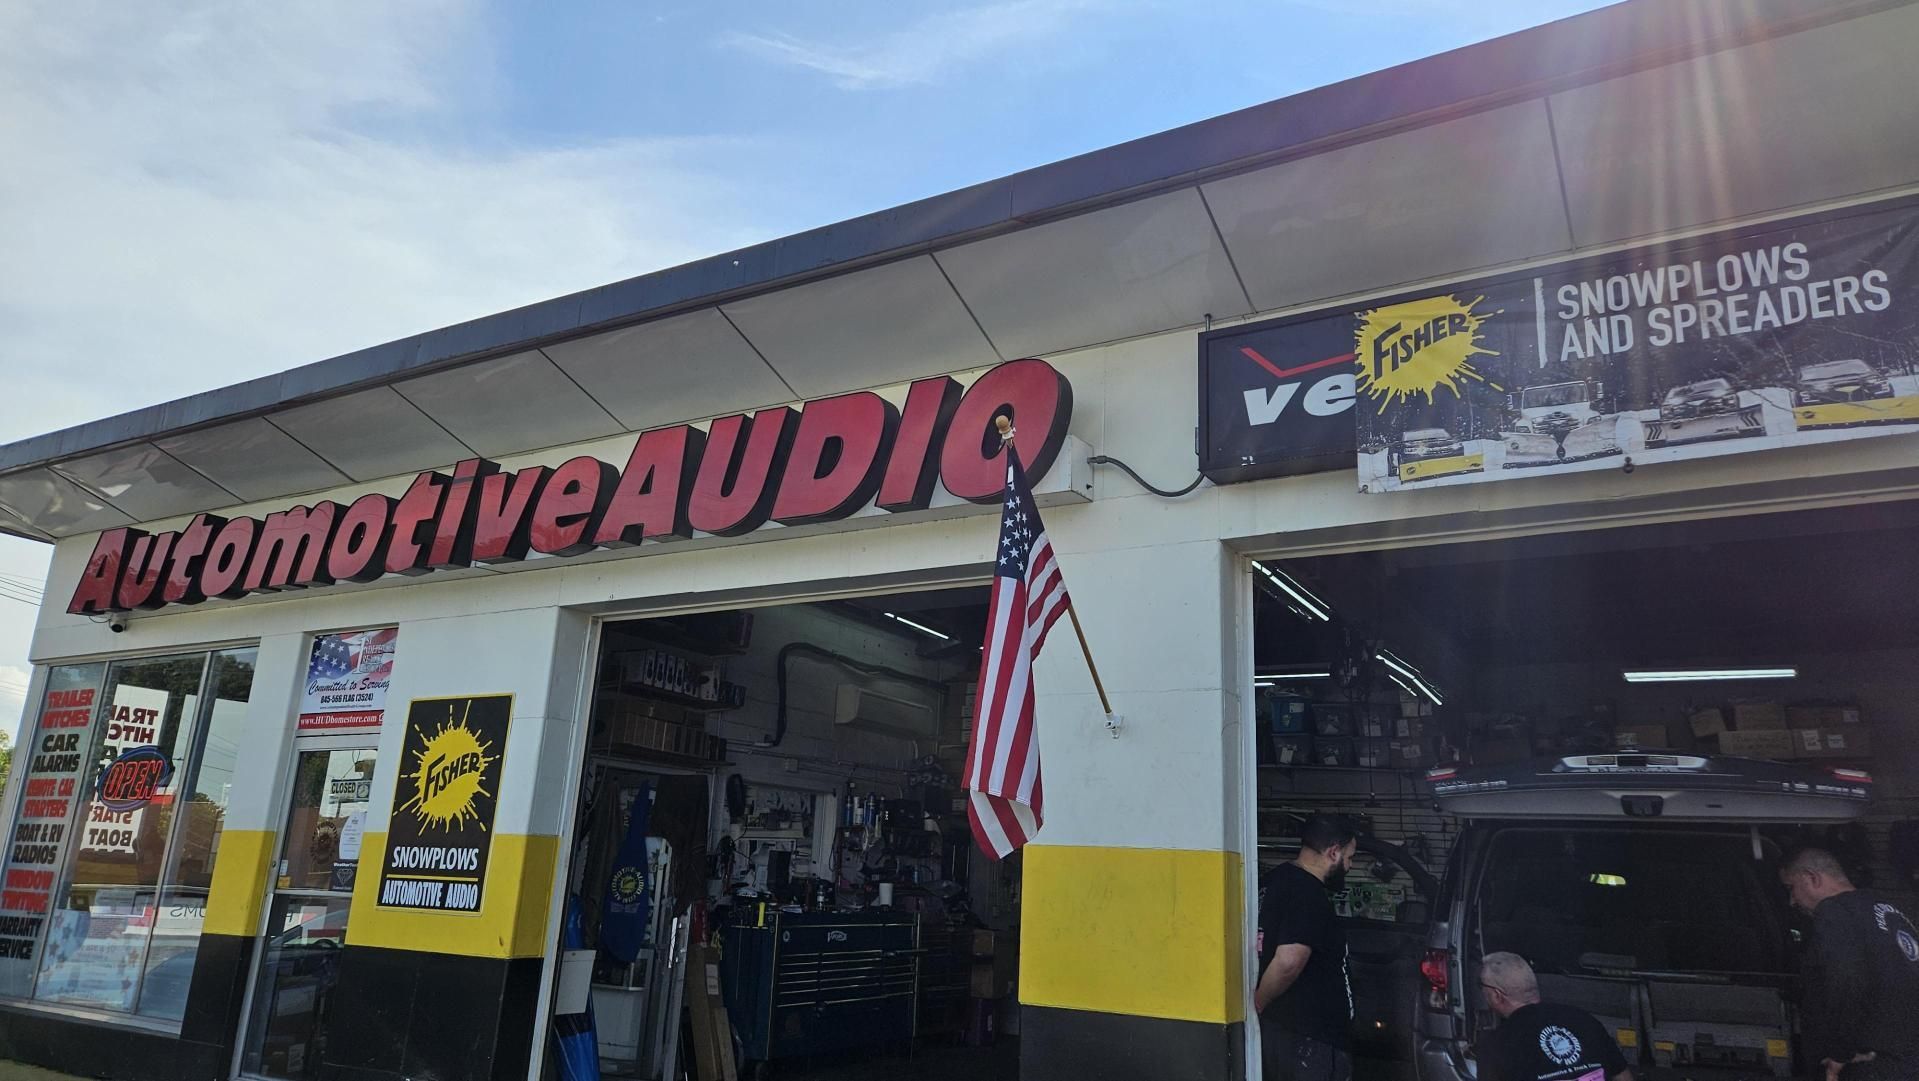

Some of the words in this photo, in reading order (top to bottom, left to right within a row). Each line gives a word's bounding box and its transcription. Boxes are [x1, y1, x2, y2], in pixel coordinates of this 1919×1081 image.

[1557, 242, 1810, 320] SNOWPLOWS
[1560, 314, 1634, 362] AND
[1647, 269, 1891, 347] SPREADERS
[1373, 313, 1471, 381] FISHER
[309, 679, 349, 695] Committed
[350, 681, 358, 690] to
[359, 678, 390, 692] Serving
[47, 689, 95, 708] TRAILER
[342, 694, 356, 702] FLAG
[300, 715, 377, 726] www.HUDhomestore.com
[42, 734, 80, 753] CAR
[32, 754, 80, 773] ALARMS
[58, 778, 75, 797] CAR
[103, 760, 163, 800] OPEN
[331, 782, 356, 794] CLOSED
[422, 751, 481, 804] FISHER
[16, 824, 41, 842] BOAT
[40, 824, 49, 842] &
[49, 824, 65, 843] RV
[12, 845, 58, 865] RADIOS
[391, 846, 480, 871] SNOWPLOWS
[6, 868, 55, 890] WINDOW
[382, 879, 444, 907] AUTOMOTIVE
[444, 883, 478, 909] AUDIO
[0, 915, 43, 938] ARRANTY
[0, 938, 34, 960] ERVICE
